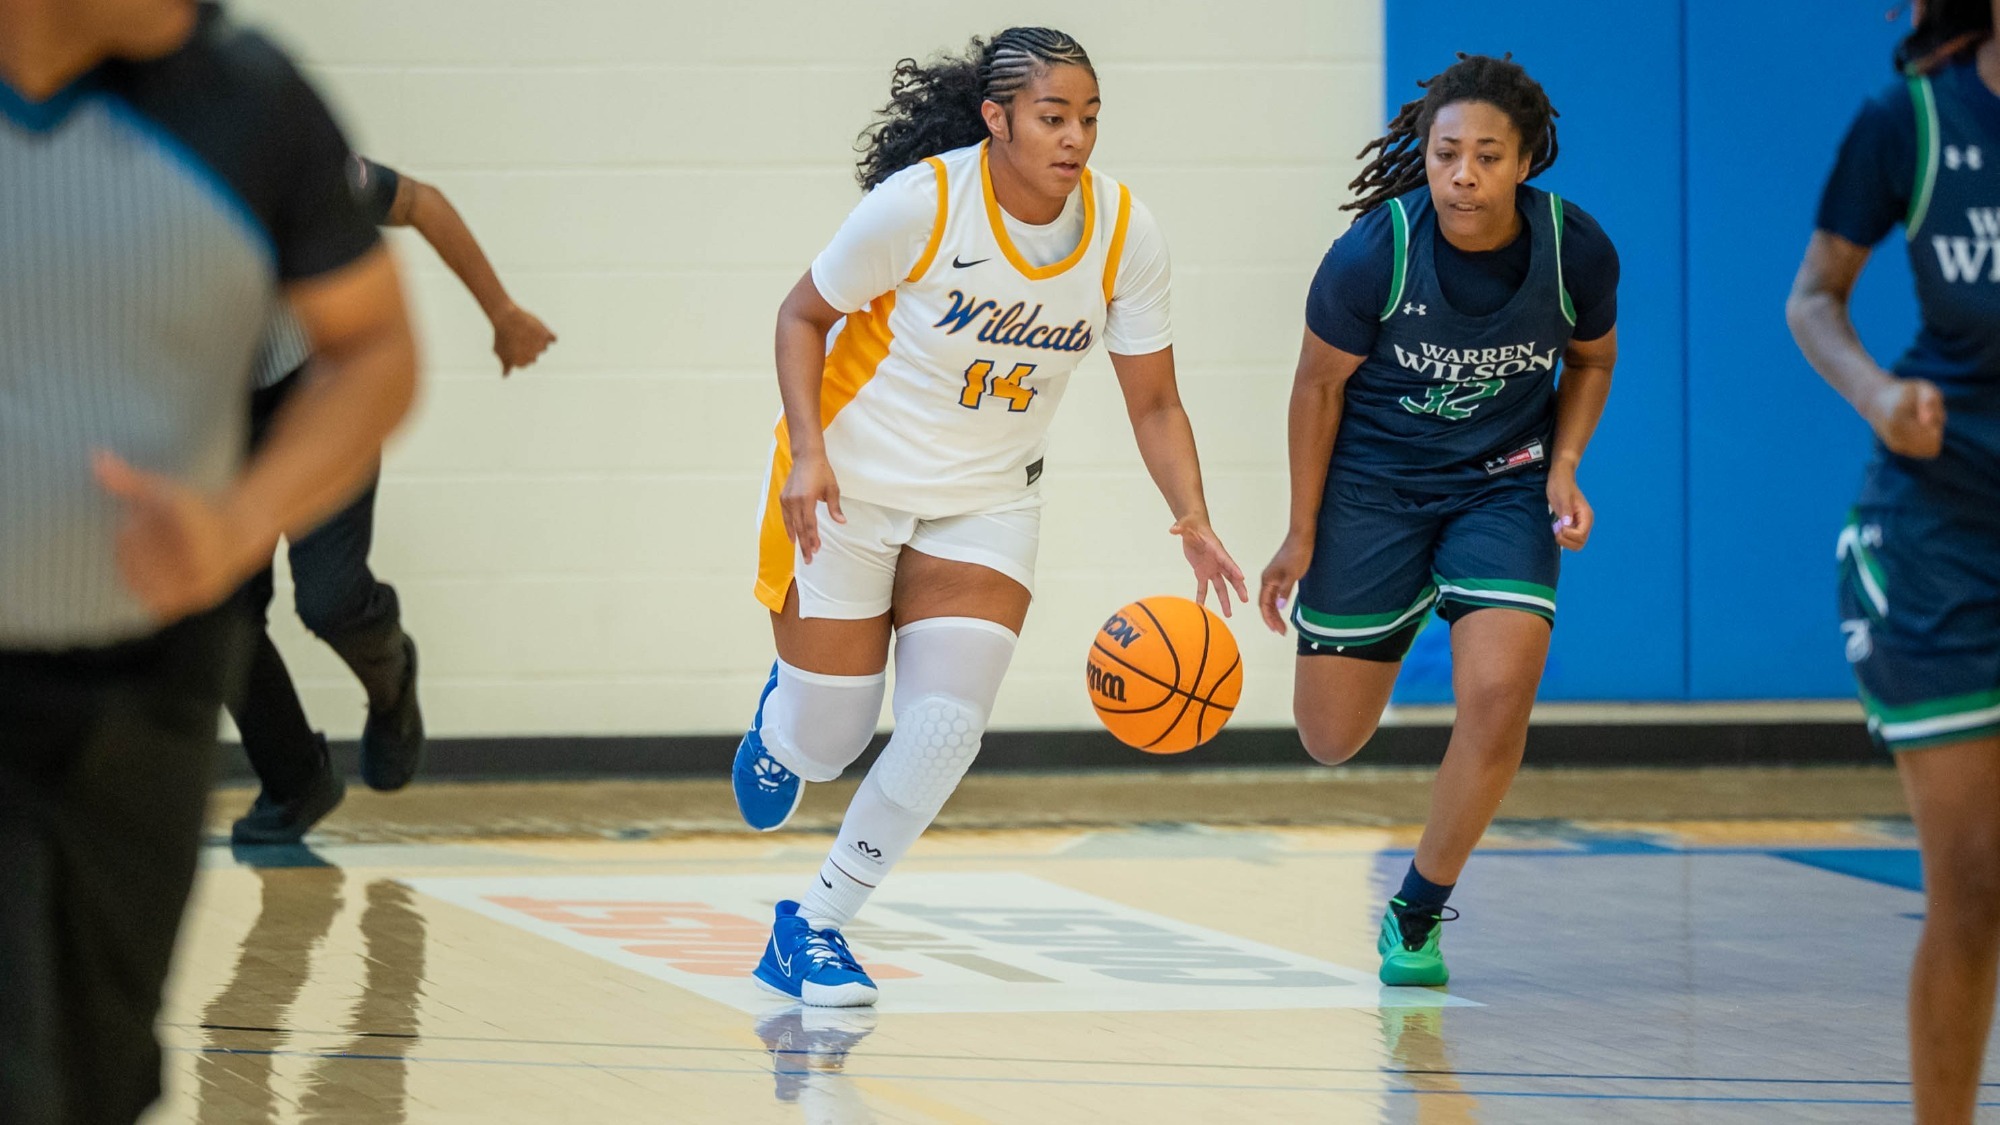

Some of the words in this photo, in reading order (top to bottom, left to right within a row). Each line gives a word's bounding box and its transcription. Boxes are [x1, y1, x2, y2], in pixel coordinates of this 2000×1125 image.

[932, 290, 1093, 352] Wildcats
[1393, 344, 1557, 382] WILSON
[1420, 341, 1536, 365] WARREN
[958, 359, 1038, 413] 14
[871, 902, 1360, 987] COAST
